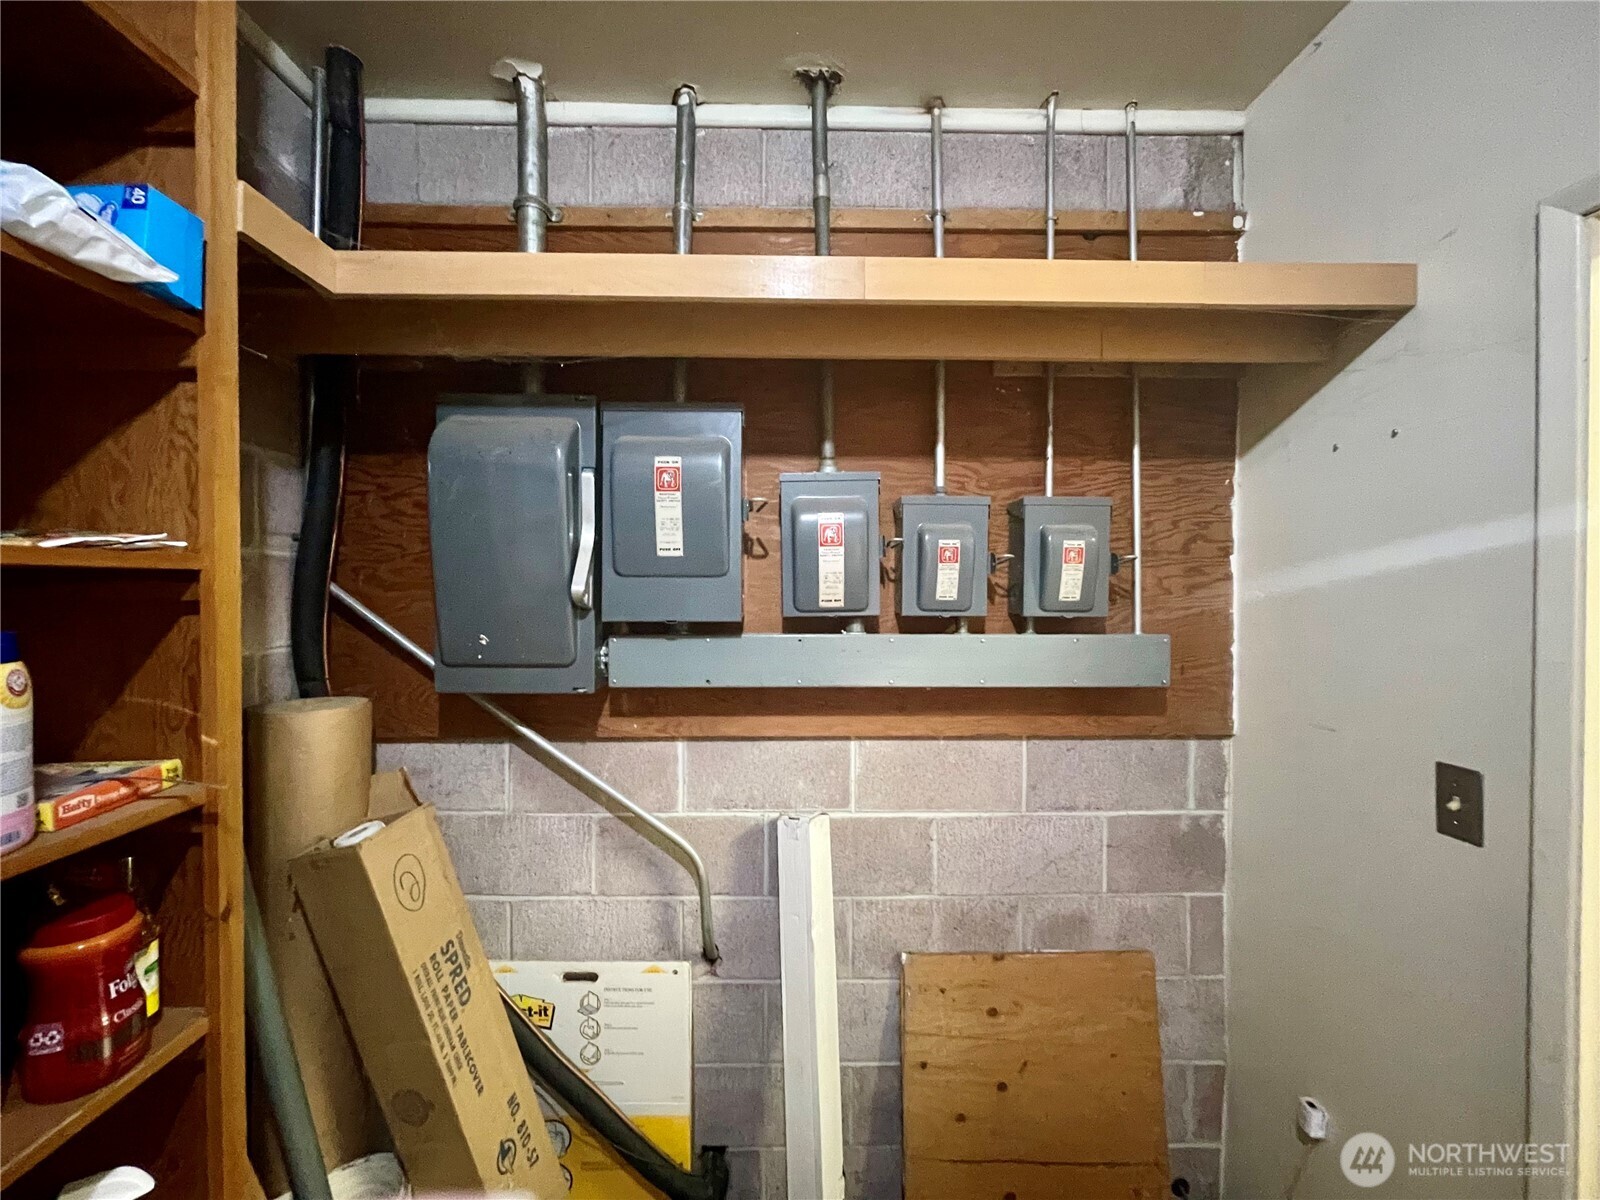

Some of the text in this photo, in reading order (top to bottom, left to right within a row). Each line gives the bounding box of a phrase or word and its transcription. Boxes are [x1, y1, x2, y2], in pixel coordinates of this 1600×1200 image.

[131, 187, 146, 205] 40
[440, 939, 471, 1007] SPRED
[429, 952, 444, 983] ROLL
[441, 984, 459, 1023] PAPER
[455, 1024, 484, 1097] TABLECOVER
[507, 1091, 539, 1168] NO. 810-57
